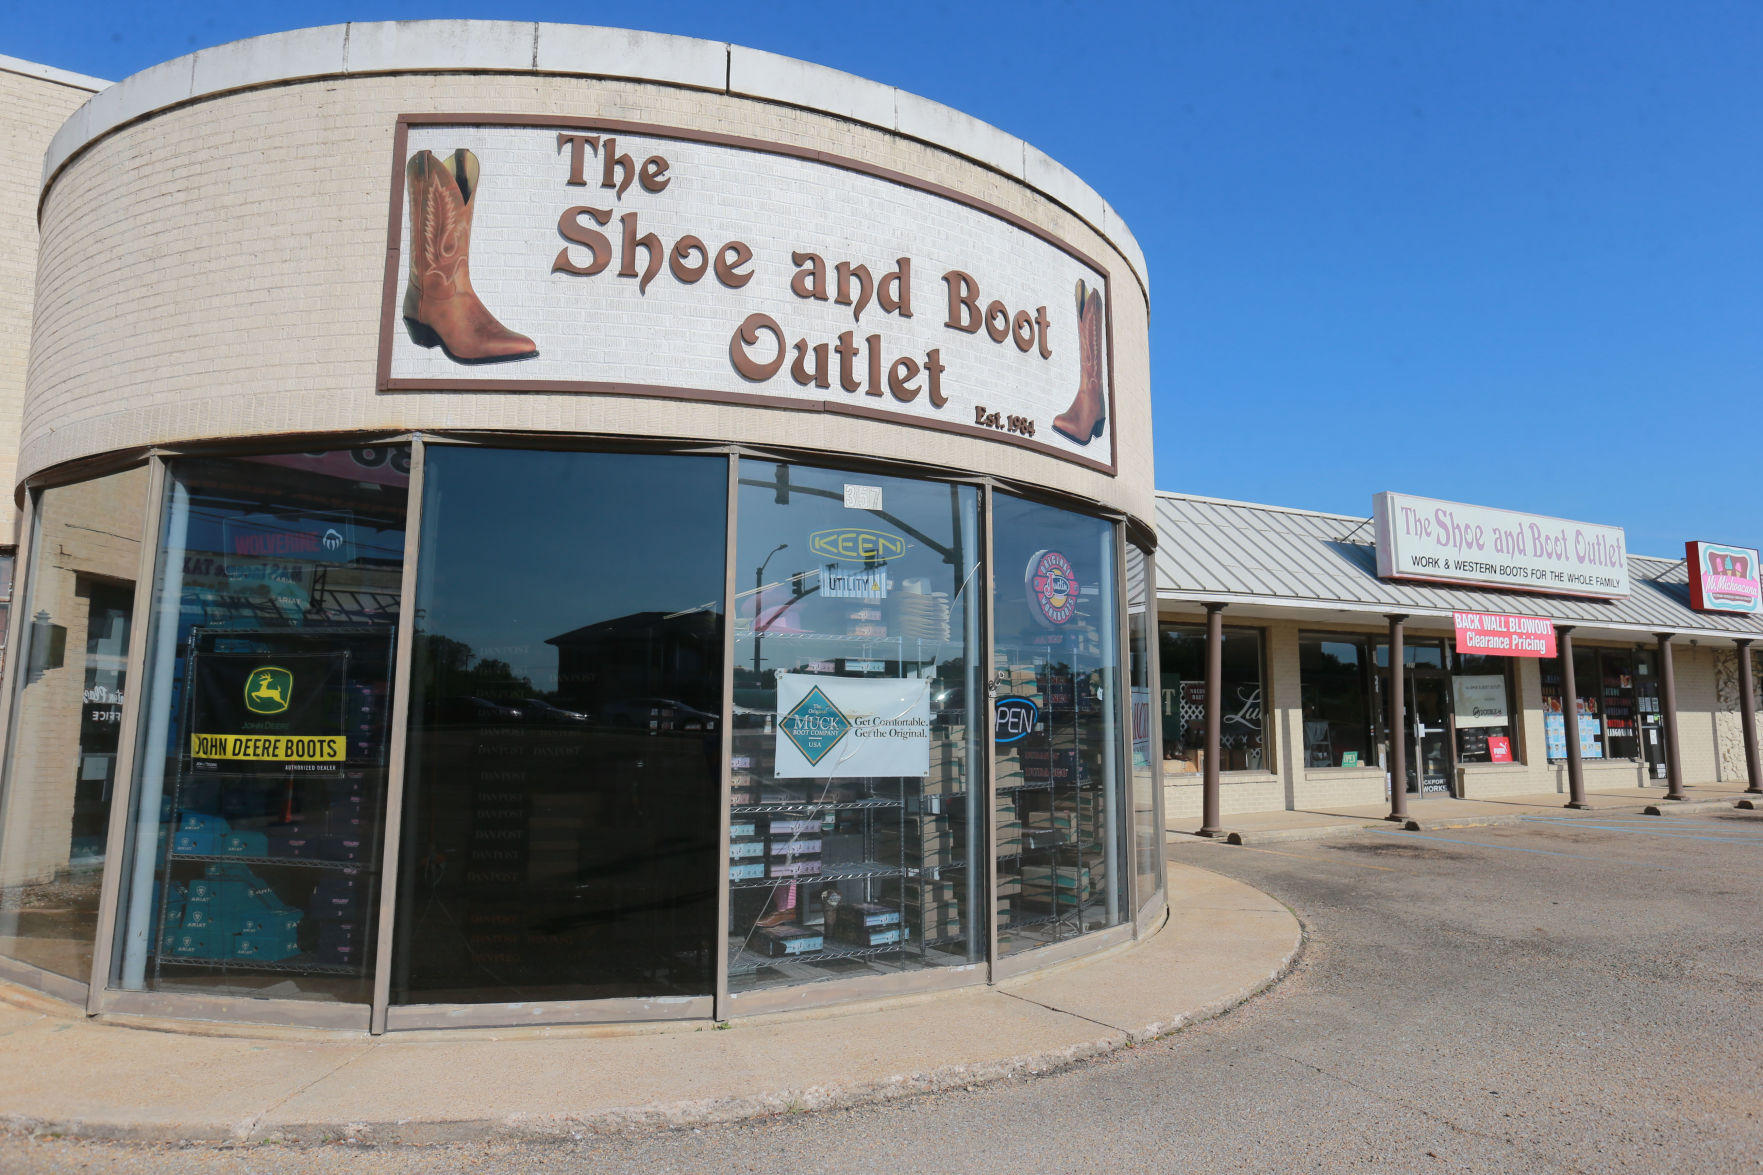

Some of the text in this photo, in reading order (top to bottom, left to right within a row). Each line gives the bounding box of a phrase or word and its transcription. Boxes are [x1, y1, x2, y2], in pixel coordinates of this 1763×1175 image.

[557, 132, 671, 201] The
[551, 205, 1053, 360] Shoe and Boot
[729, 312, 949, 408] Outlet
[975, 405, 1036, 438] Est. 1984
[845, 485, 881, 510] 357
[235, 532, 321, 557] WOLVERINE
[815, 533, 900, 556] KEEN
[1401, 506, 1624, 569] The Shoe and Boot Outlet
[829, 577, 870, 591] UTILITY
[1411, 555, 1620, 588] WORK & WESTERN BOOTS FOR THE WHOLE FAMILY
[1044, 571, 1068, 598] Justin
[1454, 613, 1552, 635] BACK WALL BLOWOUT
[1466, 631, 1546, 655] Clearance Pricing
[793, 715, 840, 730] MUCK
[854, 716, 929, 727] Get Comfortable.
[994, 707, 1034, 734] PEN
[854, 728, 928, 740] Get the Original.
[196, 737, 337, 758] JOHN DEERE BOOTS
